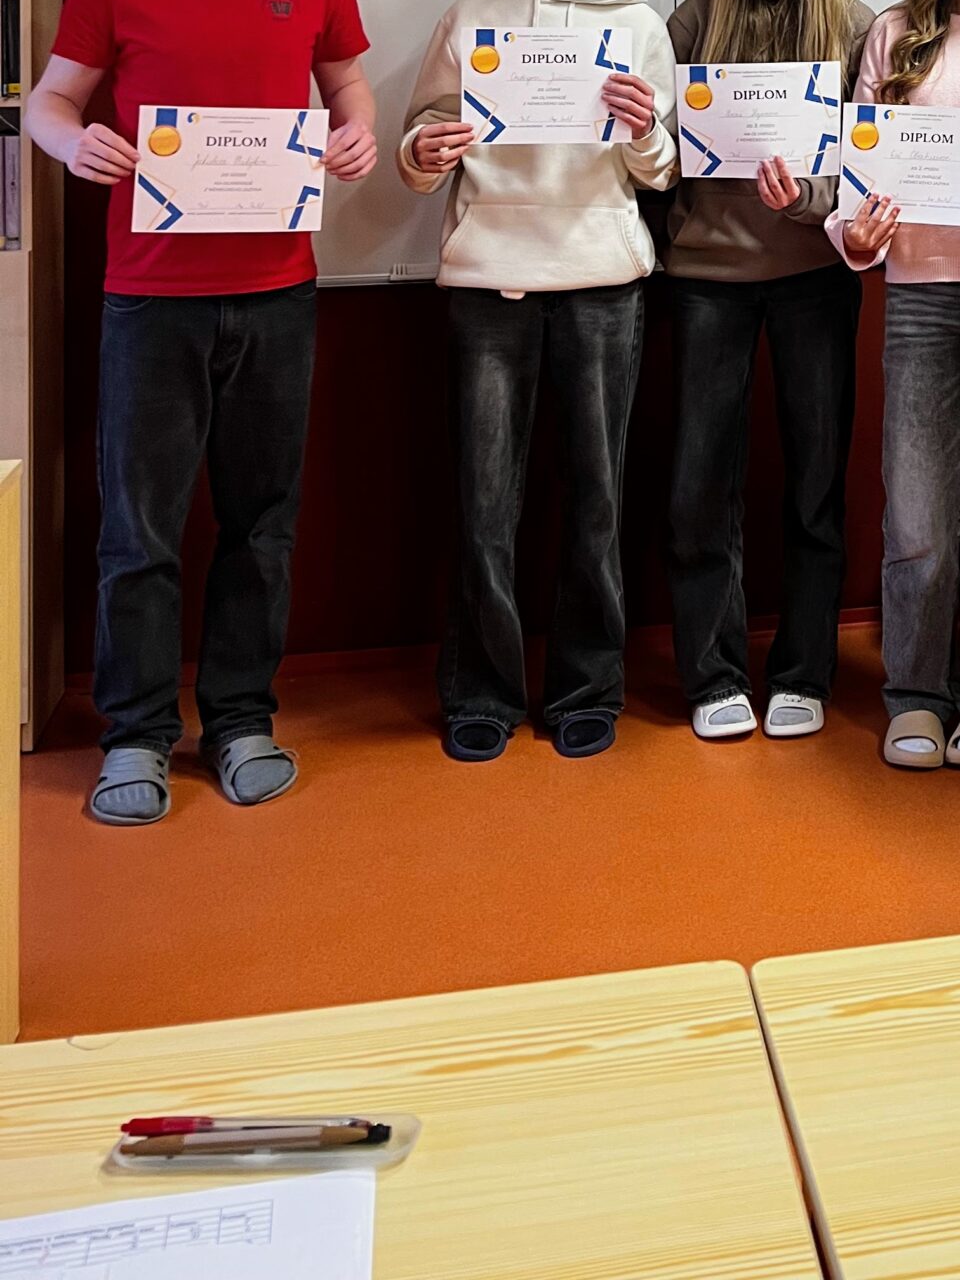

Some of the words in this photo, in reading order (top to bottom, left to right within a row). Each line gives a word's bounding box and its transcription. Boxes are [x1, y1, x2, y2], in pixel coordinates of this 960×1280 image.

[521, 53, 577, 64] DIPLOM
[733, 89, 787, 101] DIPLOM
[206, 136, 267, 148] DIPLOM
[900, 132, 954, 144] DIPLOM
